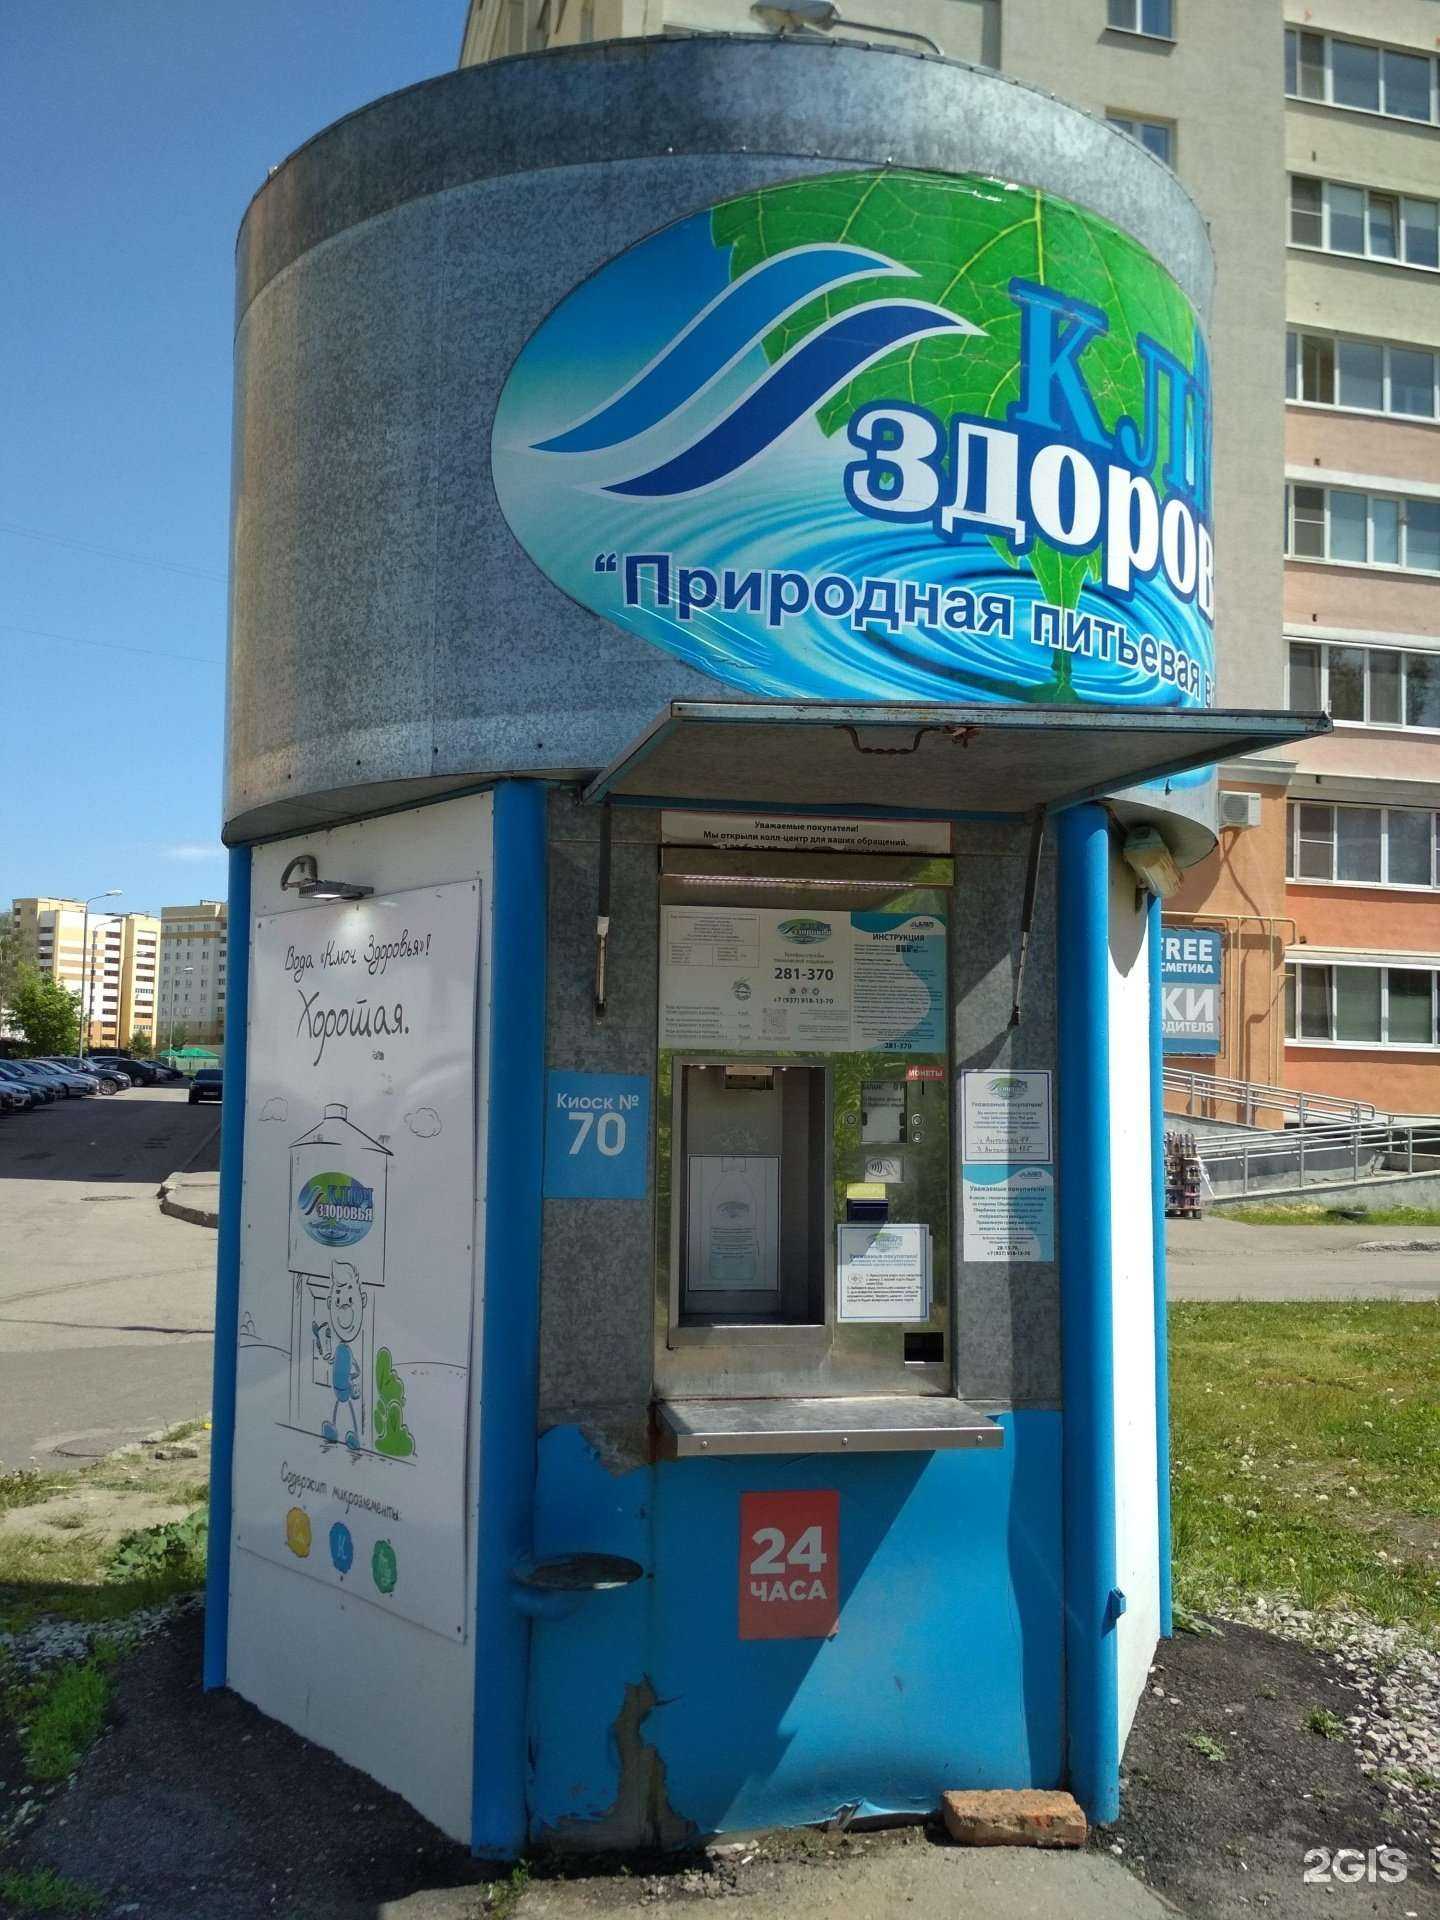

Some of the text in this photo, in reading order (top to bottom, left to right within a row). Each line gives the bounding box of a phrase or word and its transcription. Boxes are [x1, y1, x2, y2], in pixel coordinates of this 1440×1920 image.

[1031, 600, 1200, 700] питьевая
[754, 821, 805, 831] Уважаемые
[703, 830, 719, 839] Мы
[720, 832, 759, 842] открыли
[760, 833, 809, 844] колл-центр
[810, 835, 827, 845] для
[827, 836, 856, 846] ваших
[872, 933, 925, 942] ИНСТРУКЦИЯ
[1160, 937, 1213, 962] REE
[284, 943, 314, 983] Вода
[774, 967, 834, 981] 281-370
[908, 1069, 943, 1077] МОНЕТЫ
[556, 1092, 614, 1109] Киоск
[568, 1112, 626, 1156] 70
[280, 1461, 328, 1498] Содержит
[750, 1526, 827, 1574] 24
[750, 1579, 828, 1602] ЧАСА
